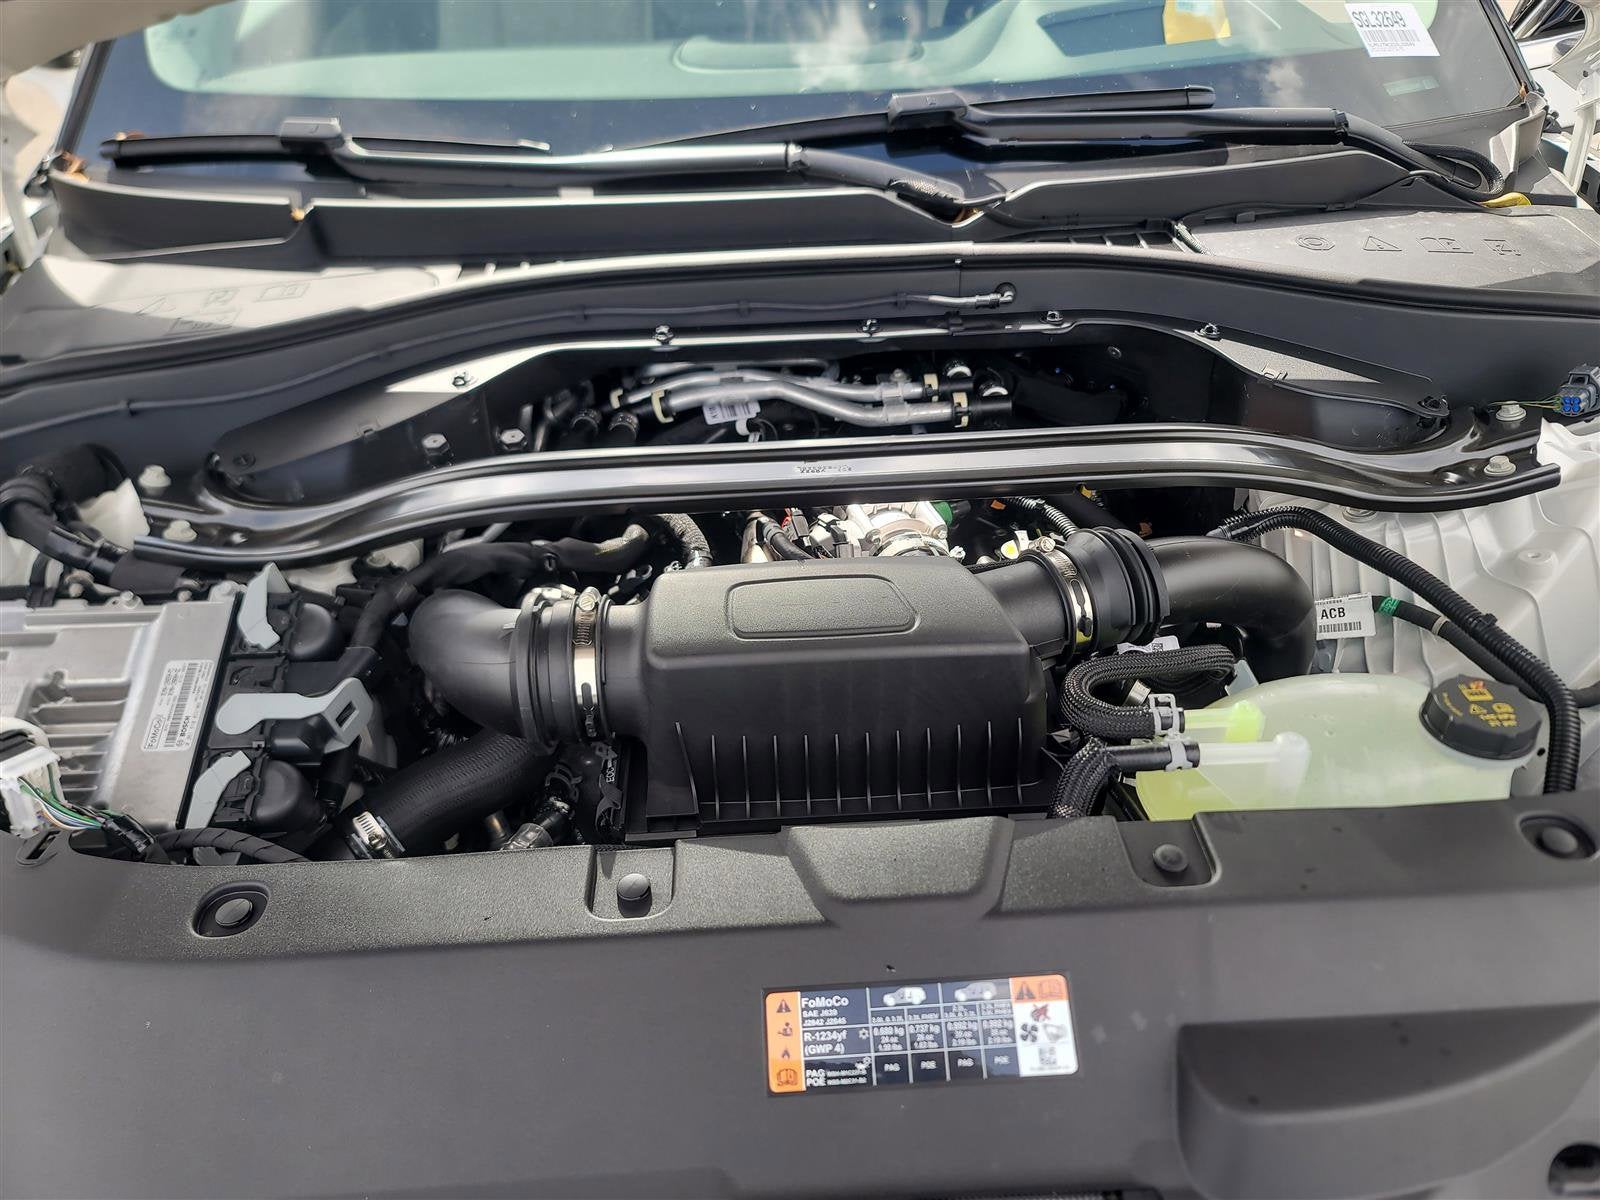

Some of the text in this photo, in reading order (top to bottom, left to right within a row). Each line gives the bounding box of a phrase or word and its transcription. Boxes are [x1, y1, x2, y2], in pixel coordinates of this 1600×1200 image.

[1351, 10, 1408, 28] SGL32649
[1320, 607, 1346, 620] ACB
[801, 995, 849, 1008] FoMoCo
[803, 1029, 848, 1042] R-1234yf
[804, 1042, 845, 1056] (GWP 4)
